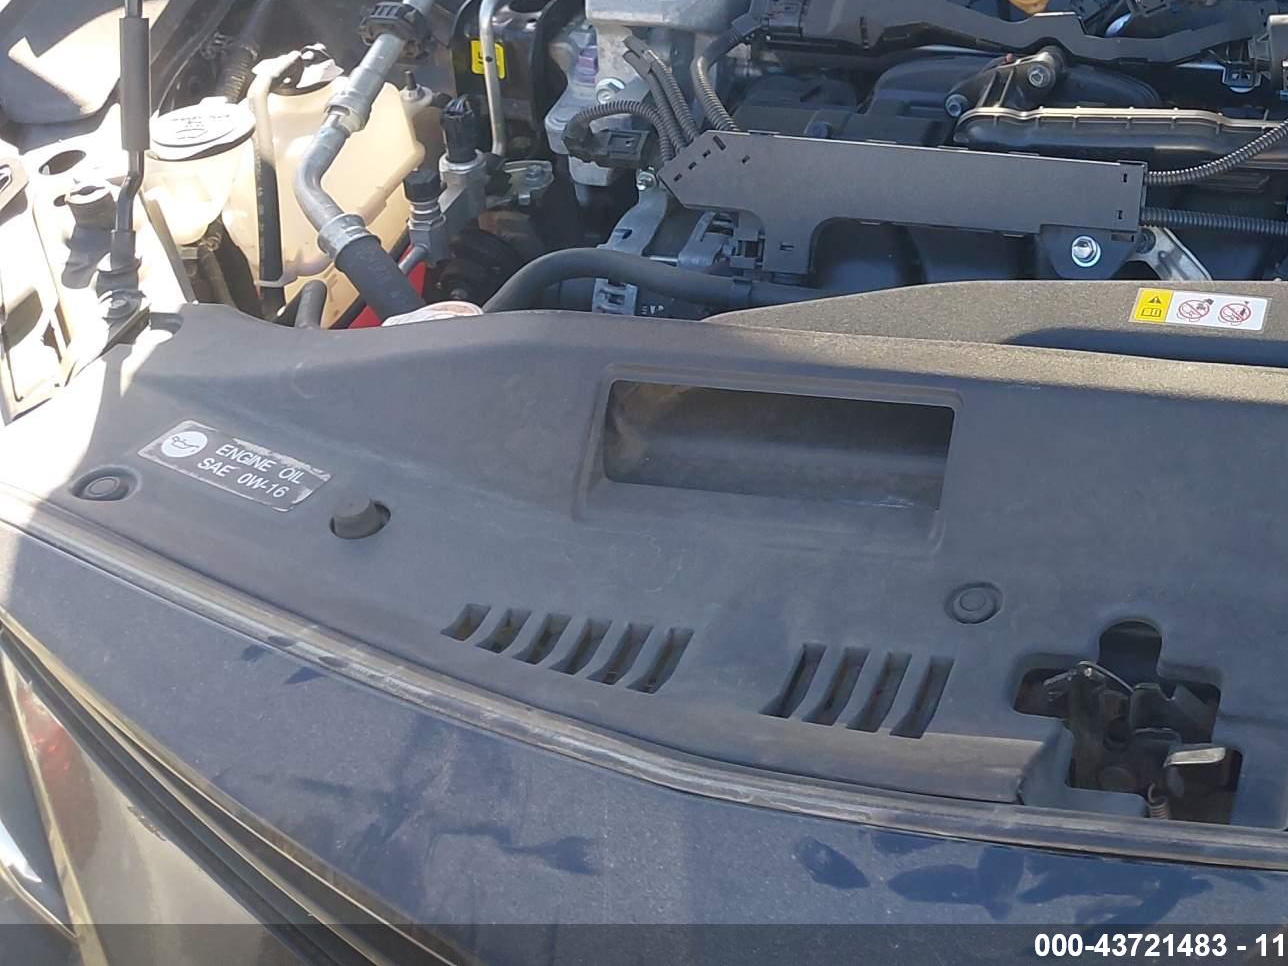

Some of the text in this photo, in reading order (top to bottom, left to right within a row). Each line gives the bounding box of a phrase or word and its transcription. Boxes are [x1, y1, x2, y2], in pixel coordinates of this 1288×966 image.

[197, 457, 290, 498] SAE 0W-16
[215, 443, 305, 484] ENGINE OIL
